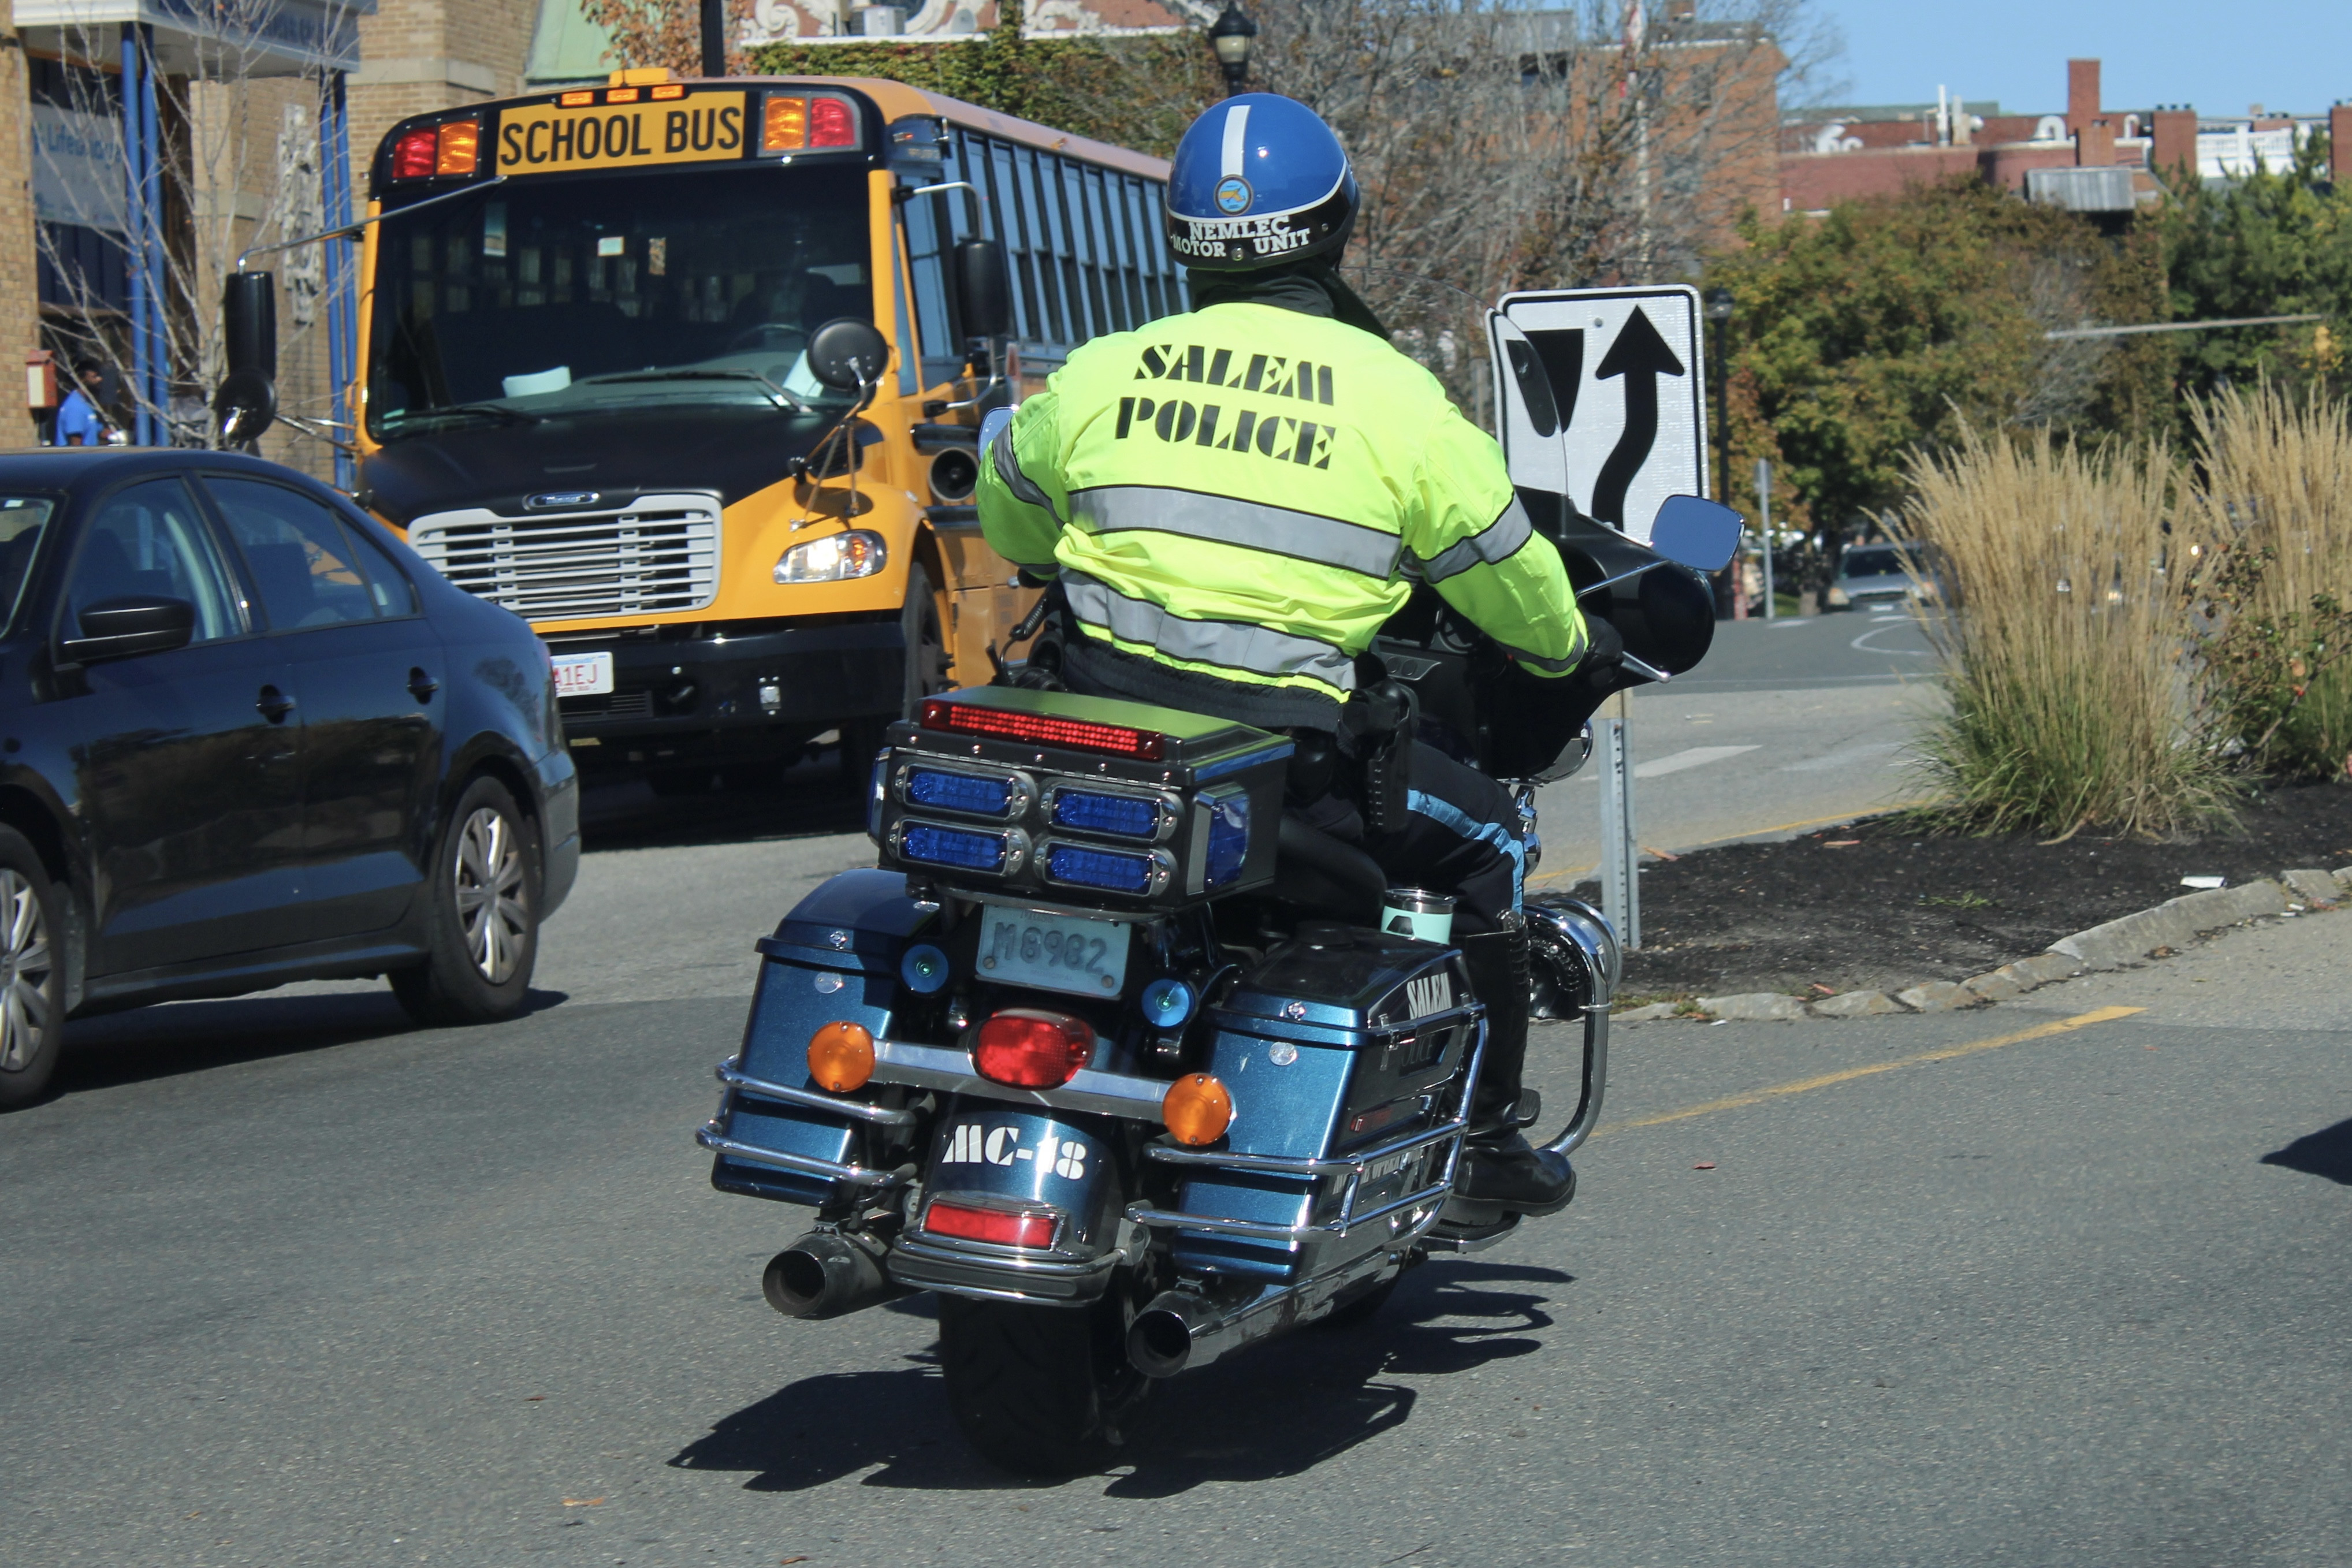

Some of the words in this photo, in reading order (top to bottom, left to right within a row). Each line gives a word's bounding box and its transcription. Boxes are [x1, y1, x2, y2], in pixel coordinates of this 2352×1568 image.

[500, 113, 651, 166] SCHOOL
[665, 107, 740, 153] BUS
[1172, 234, 1227, 257] MOTOR
[1253, 228, 1310, 254] UNIT
[1188, 215, 1292, 241] NEMLEC
[1134, 344, 1334, 406] SALEM
[1115, 397, 1337, 470] POLICE
[992, 922, 1107, 975] M8982
[1406, 972, 1453, 1020] SALEM
[941, 1124, 1087, 1180] MC-18
